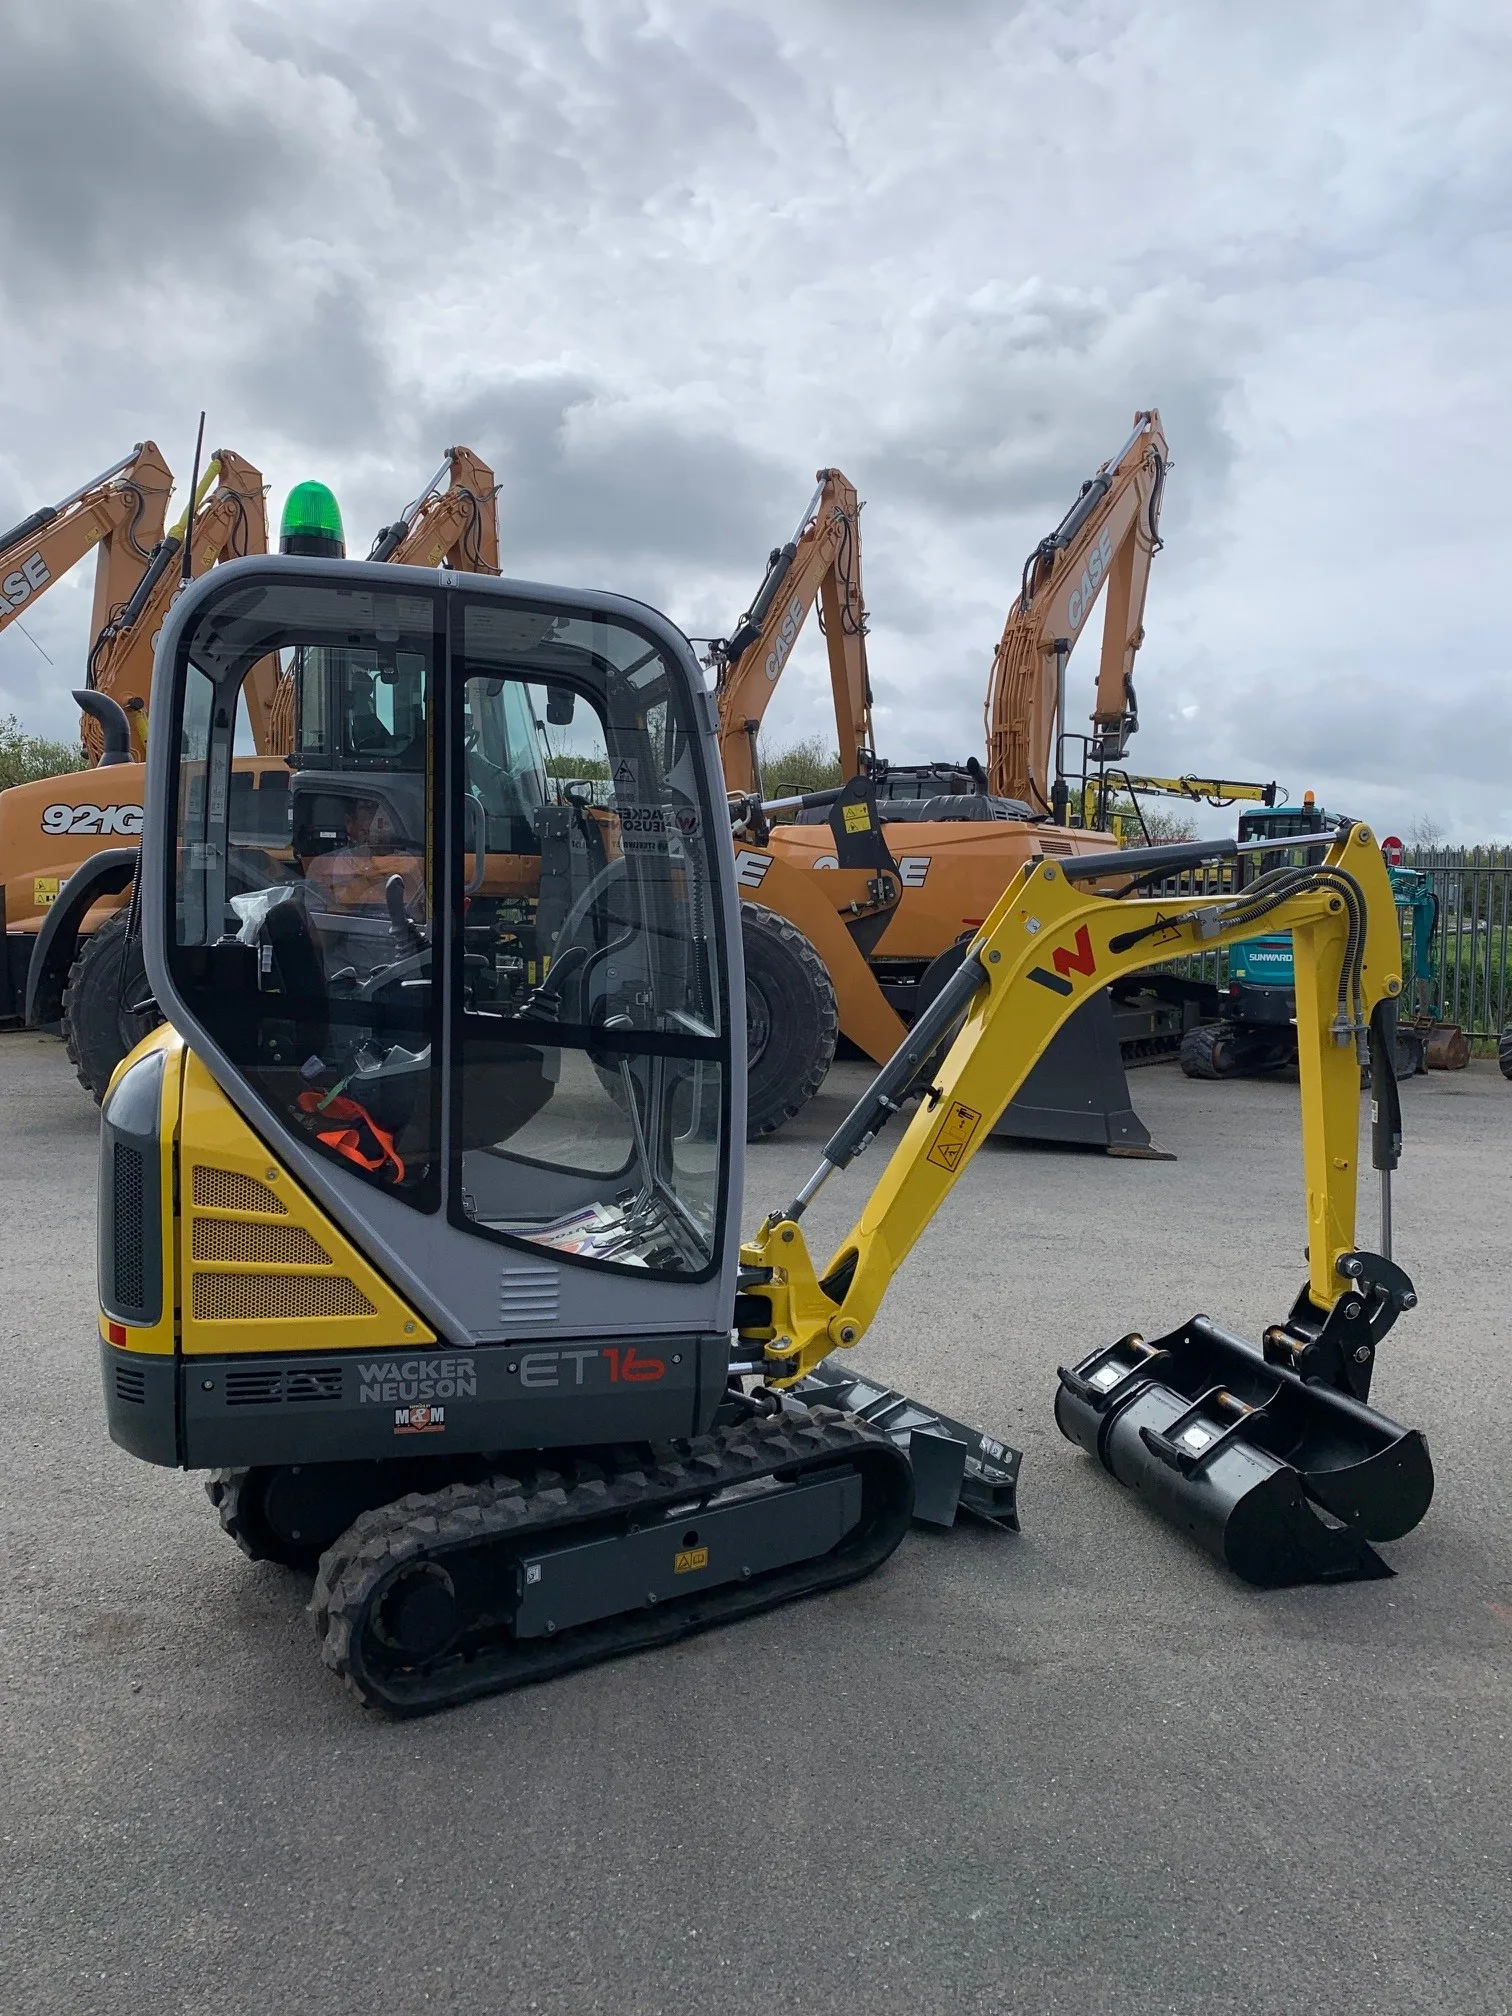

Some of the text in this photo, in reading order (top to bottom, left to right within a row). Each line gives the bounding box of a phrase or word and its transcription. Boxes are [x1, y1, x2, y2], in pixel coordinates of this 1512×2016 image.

[1068, 524, 1112, 631] CASE
[765, 594, 804, 681] CASE
[41, 804, 144, 835] 921G
[1249, 953, 1293, 962] SUNWARD
[356, 1358, 477, 1383] WACKER
[359, 1377, 477, 1403] NEUSON
